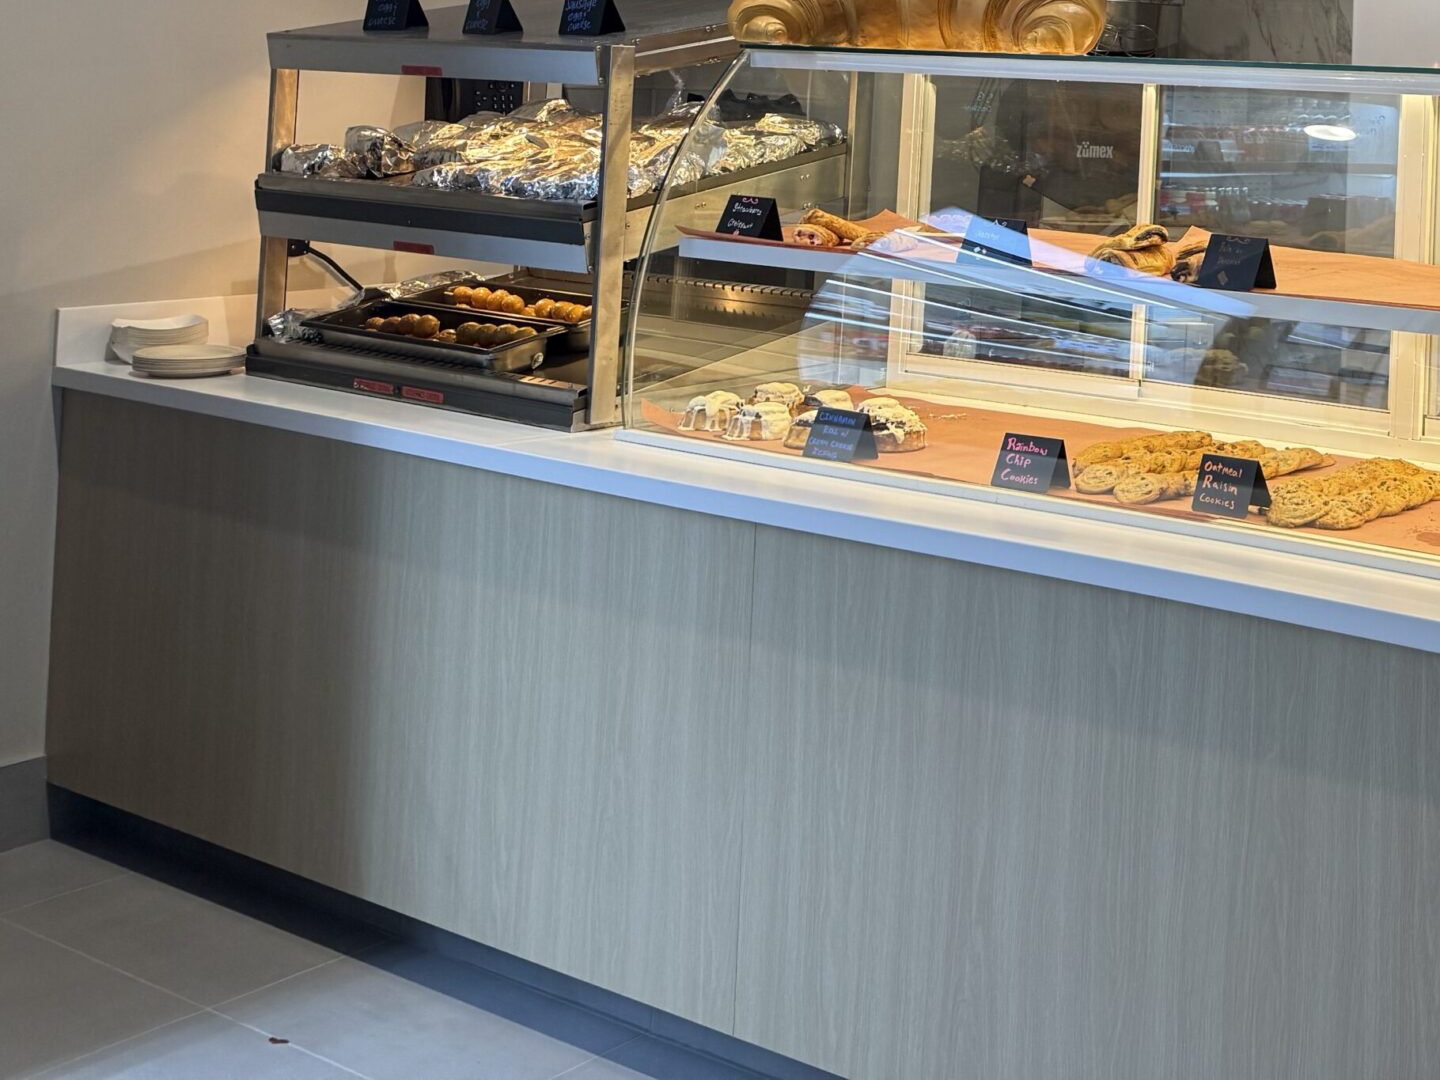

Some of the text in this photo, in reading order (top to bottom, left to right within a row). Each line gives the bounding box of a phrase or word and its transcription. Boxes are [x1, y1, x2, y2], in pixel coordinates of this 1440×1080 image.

[1007, 437, 1048, 455] Rainbow
[1006, 453, 1031, 468] Chip
[1001, 468, 1038, 485] Cookies
[1204, 461, 1243, 478] Oatmeal
[1202, 475, 1237, 495] Raisin
[1200, 493, 1234, 509] Cookies
